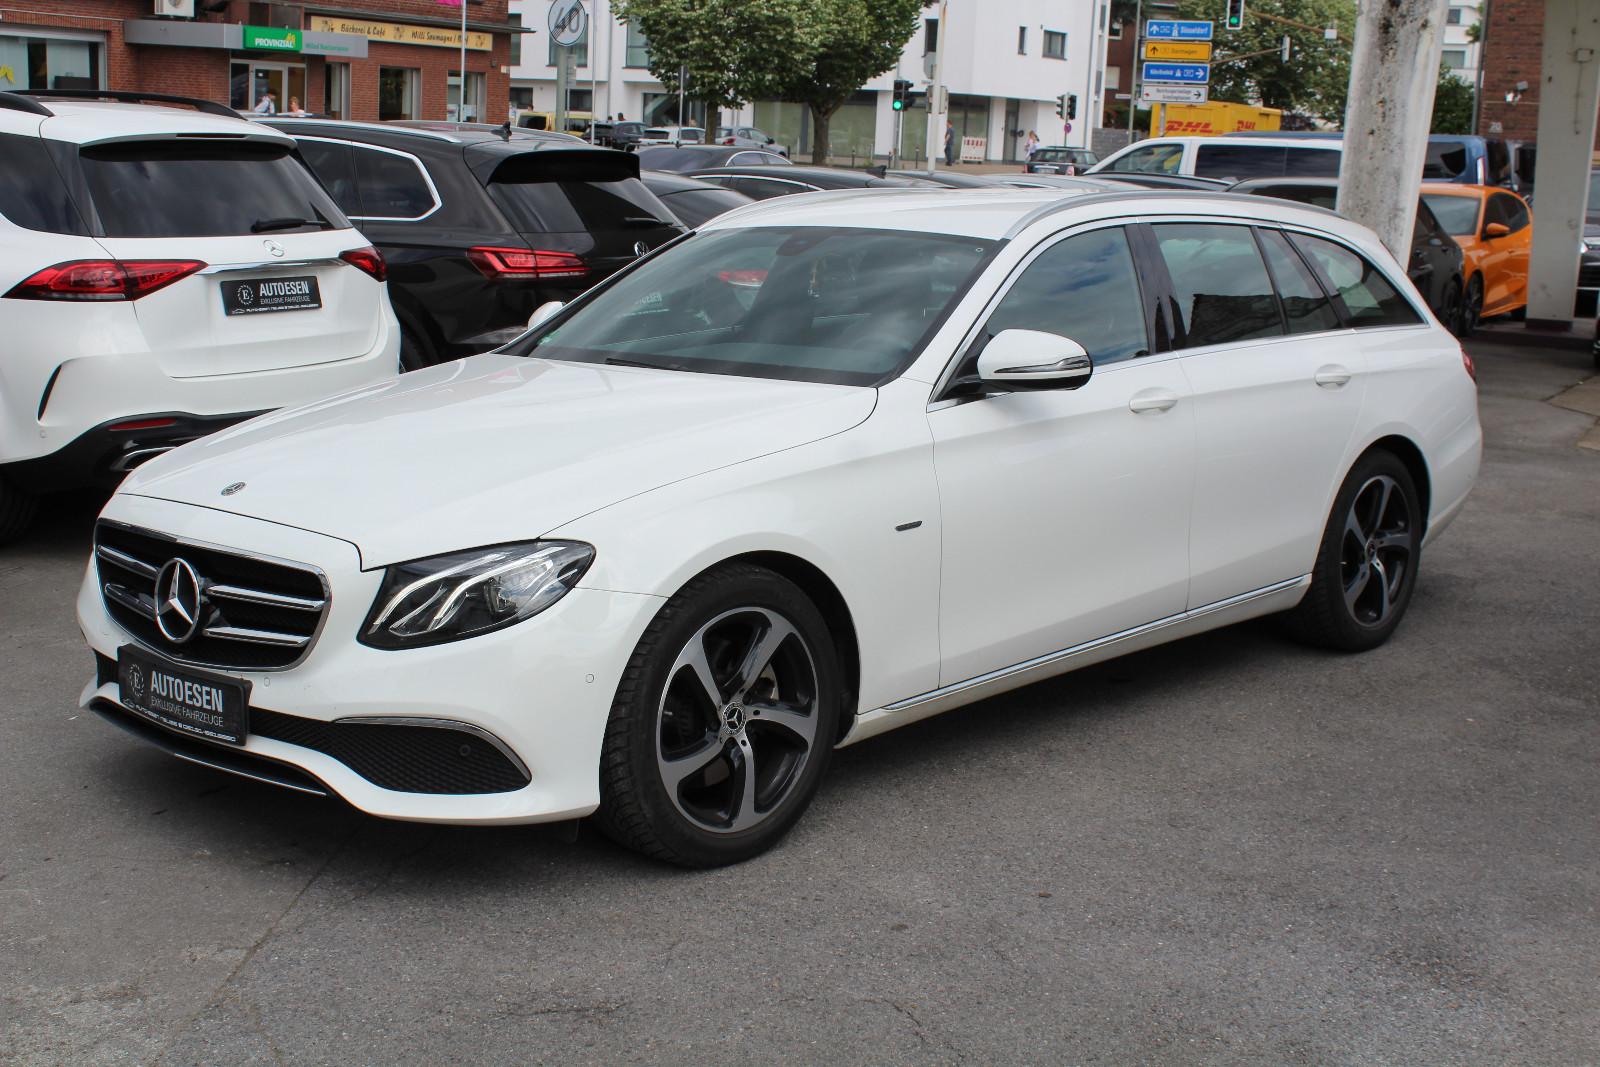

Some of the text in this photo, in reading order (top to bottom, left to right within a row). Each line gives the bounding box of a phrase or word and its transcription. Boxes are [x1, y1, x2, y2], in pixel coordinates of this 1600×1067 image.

[554, 7, 580, 33] 40
[340, 23, 366, 34] Bäckerei
[372, 26, 386, 37] Café
[411, 31, 425, 40] Willi
[254, 37, 294, 49] PROVINZIAL
[1165, 120, 1213, 133] DHL
[260, 281, 309, 296] AUTOESEN
[150, 670, 223, 712] AUTOESEN
[151, 695, 182, 716] EXKLUSIVE
[182, 706, 224, 728] FAHRZEUGE
